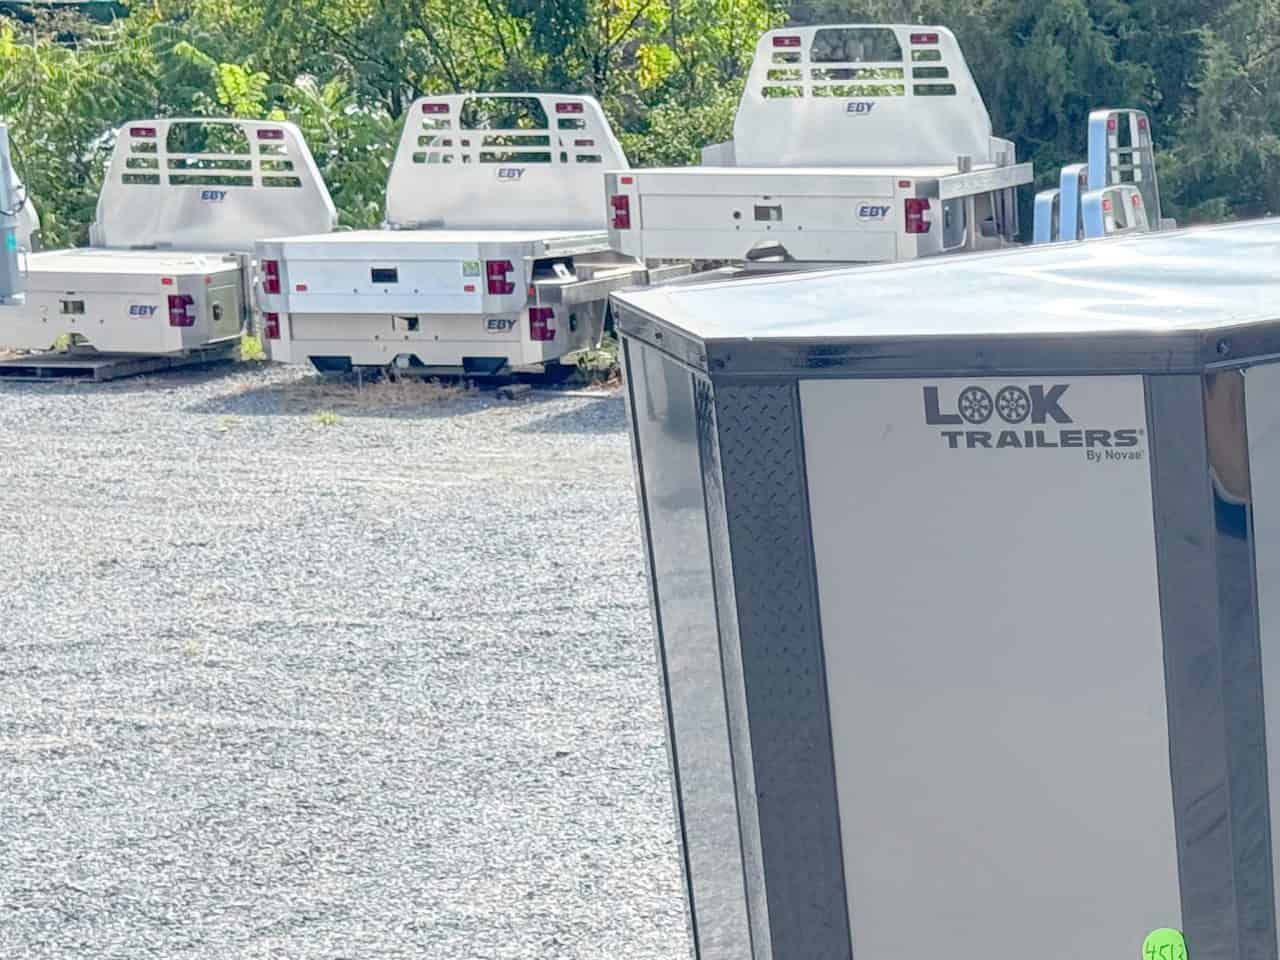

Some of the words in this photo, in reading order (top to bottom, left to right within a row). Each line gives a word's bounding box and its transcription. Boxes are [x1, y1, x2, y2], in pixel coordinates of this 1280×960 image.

[847, 102, 875, 112] EBY
[498, 168, 525, 178] EBY
[201, 190, 226, 200] EBY
[859, 206, 890, 217] EBY
[129, 305, 157, 315] EBY
[487, 319, 516, 330] EBY
[923, 384, 1073, 425] LOOK
[941, 429, 1139, 448] TRAILERS
[1086, 450, 1101, 462] By
